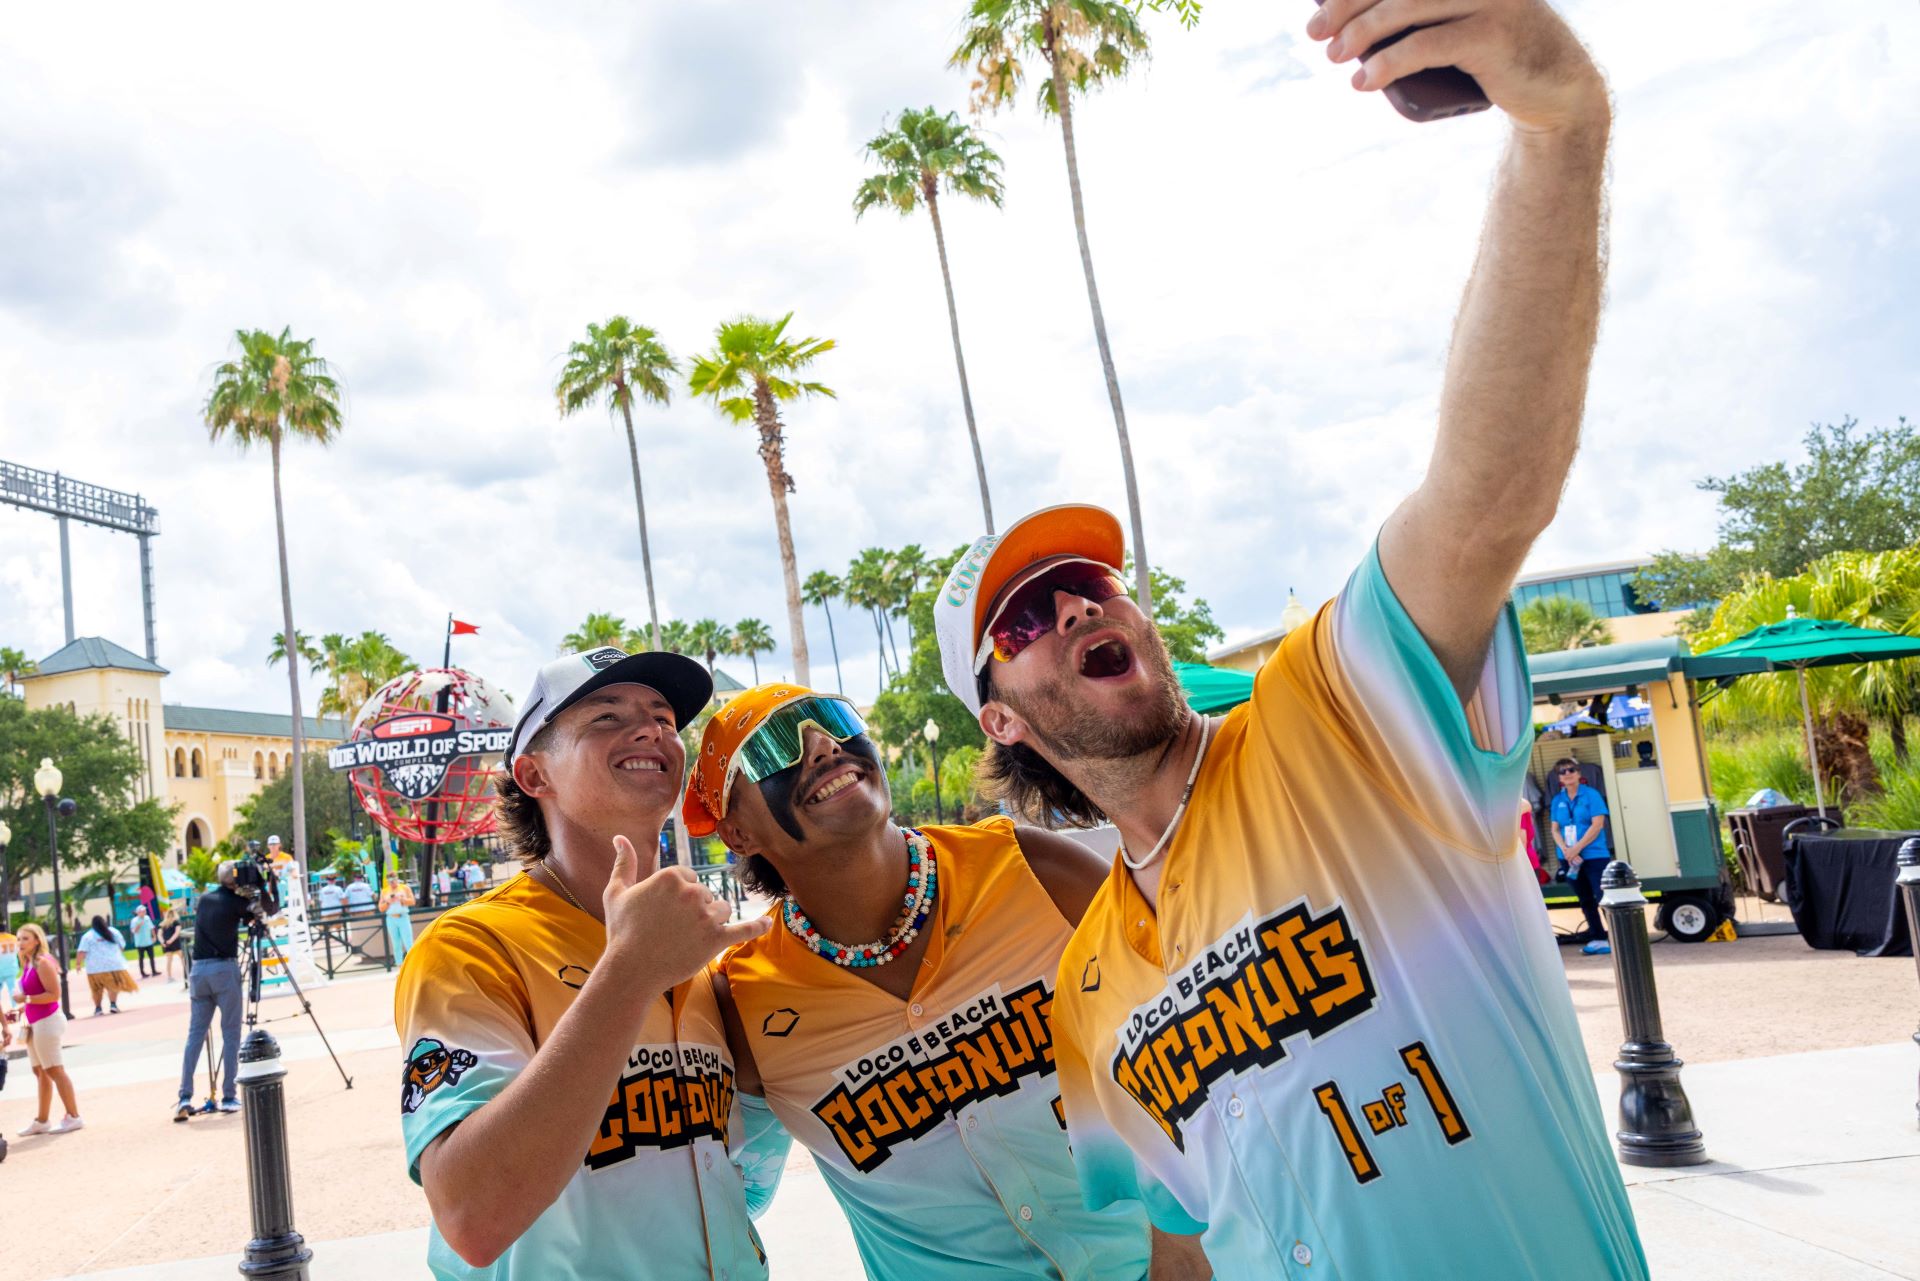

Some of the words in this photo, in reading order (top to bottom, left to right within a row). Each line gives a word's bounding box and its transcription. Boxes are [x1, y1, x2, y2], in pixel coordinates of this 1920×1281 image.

[356, 738, 429, 764] WORLD
[432, 738, 456, 754] OF
[457, 731, 512, 753] SPOR
[390, 719, 432, 735] ESPN
[394, 757, 433, 766] COMPLEX
[1126, 996, 1174, 1046] LOCO
[1176, 927, 1253, 999] BEACH
[845, 1045, 904, 1083] LOCO
[924, 995, 998, 1049] BEACH
[1114, 903, 1376, 1154] COCONUTS
[628, 1048, 673, 1069] LOCO
[683, 1048, 719, 1070] BEACH
[1312, 1080, 1382, 1184] 1
[1399, 1041, 1472, 1145] 1
